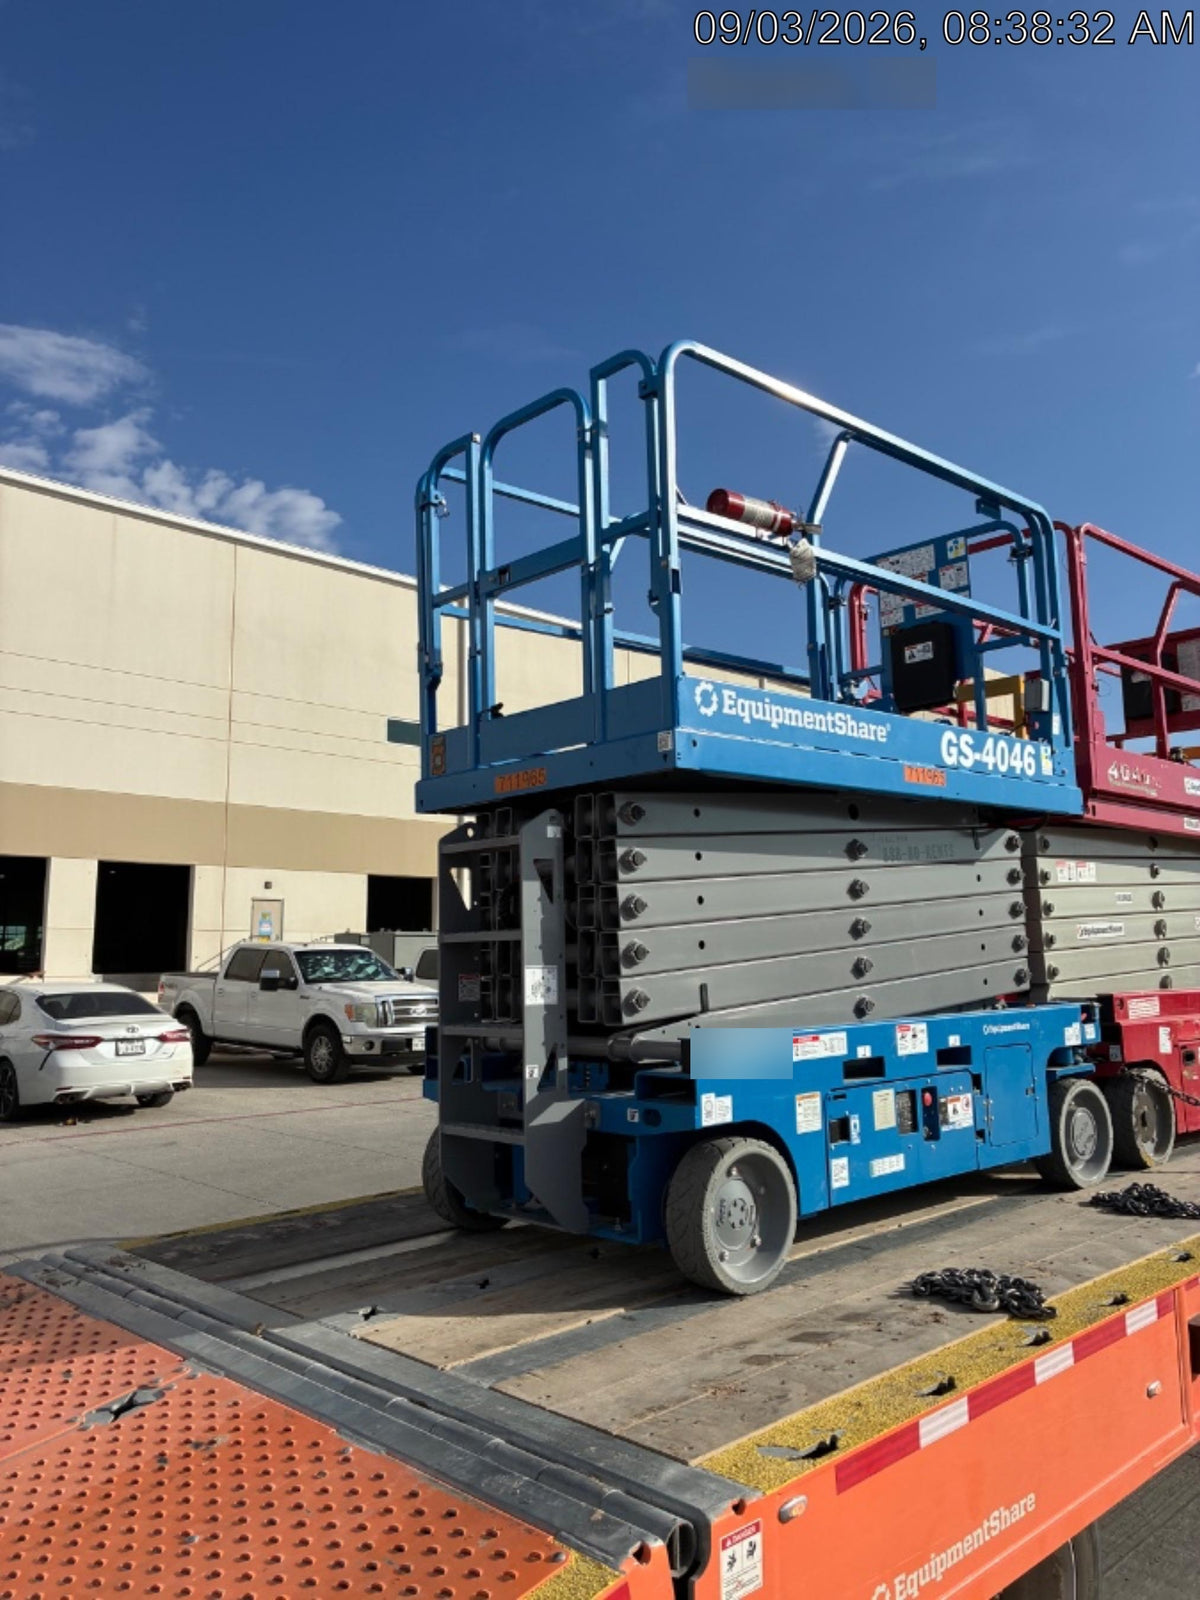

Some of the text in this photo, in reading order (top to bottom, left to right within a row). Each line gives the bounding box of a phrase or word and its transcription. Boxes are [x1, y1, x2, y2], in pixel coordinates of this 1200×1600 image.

[722, 688, 888, 743] EquipmentShare
[940, 730, 1036, 776] GS-4046
[895, 1491, 1037, 1600] EquipmentShare
